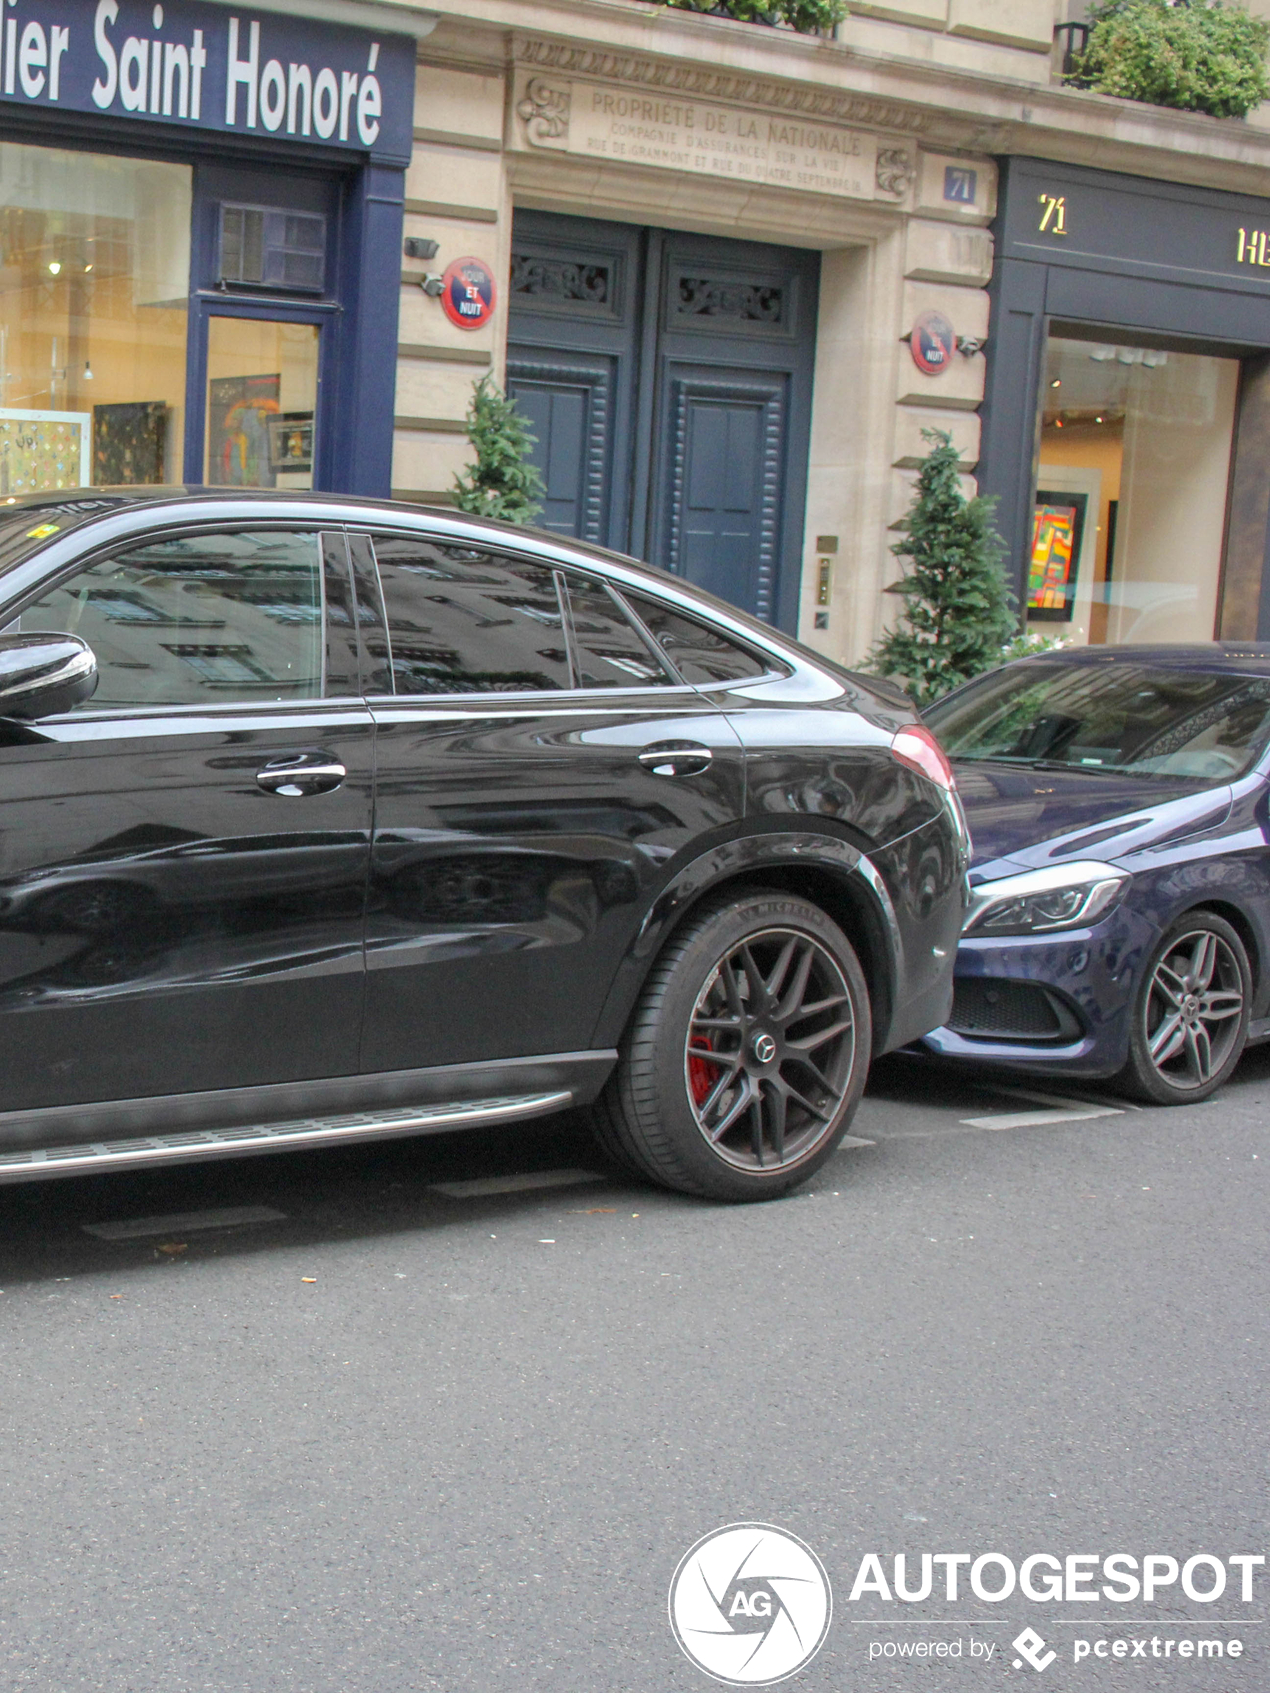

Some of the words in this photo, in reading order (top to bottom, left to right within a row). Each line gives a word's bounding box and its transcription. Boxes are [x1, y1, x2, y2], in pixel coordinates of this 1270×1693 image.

[92, 0, 207, 121] Saint
[225, 17, 382, 146] Honoré
[591, 92, 695, 129] PROPRIÉTÉ
[705, 111, 728, 134] DE
[737, 117, 758, 140] LA
[768, 121, 861, 157] NATIONALE
[587, 137, 607, 152] RUE
[712, 157, 733, 172] RUE
[611, 121, 678, 145] COMPAGNIE
[775, 150, 797, 165] SUR
[804, 155, 818, 169] LA
[823, 158, 839, 172] VIE
[951, 171, 971, 199] 71
[1039, 194, 1068, 235] 71
[459, 301, 482, 316] NUIT
[465, 286, 479, 299] ET
